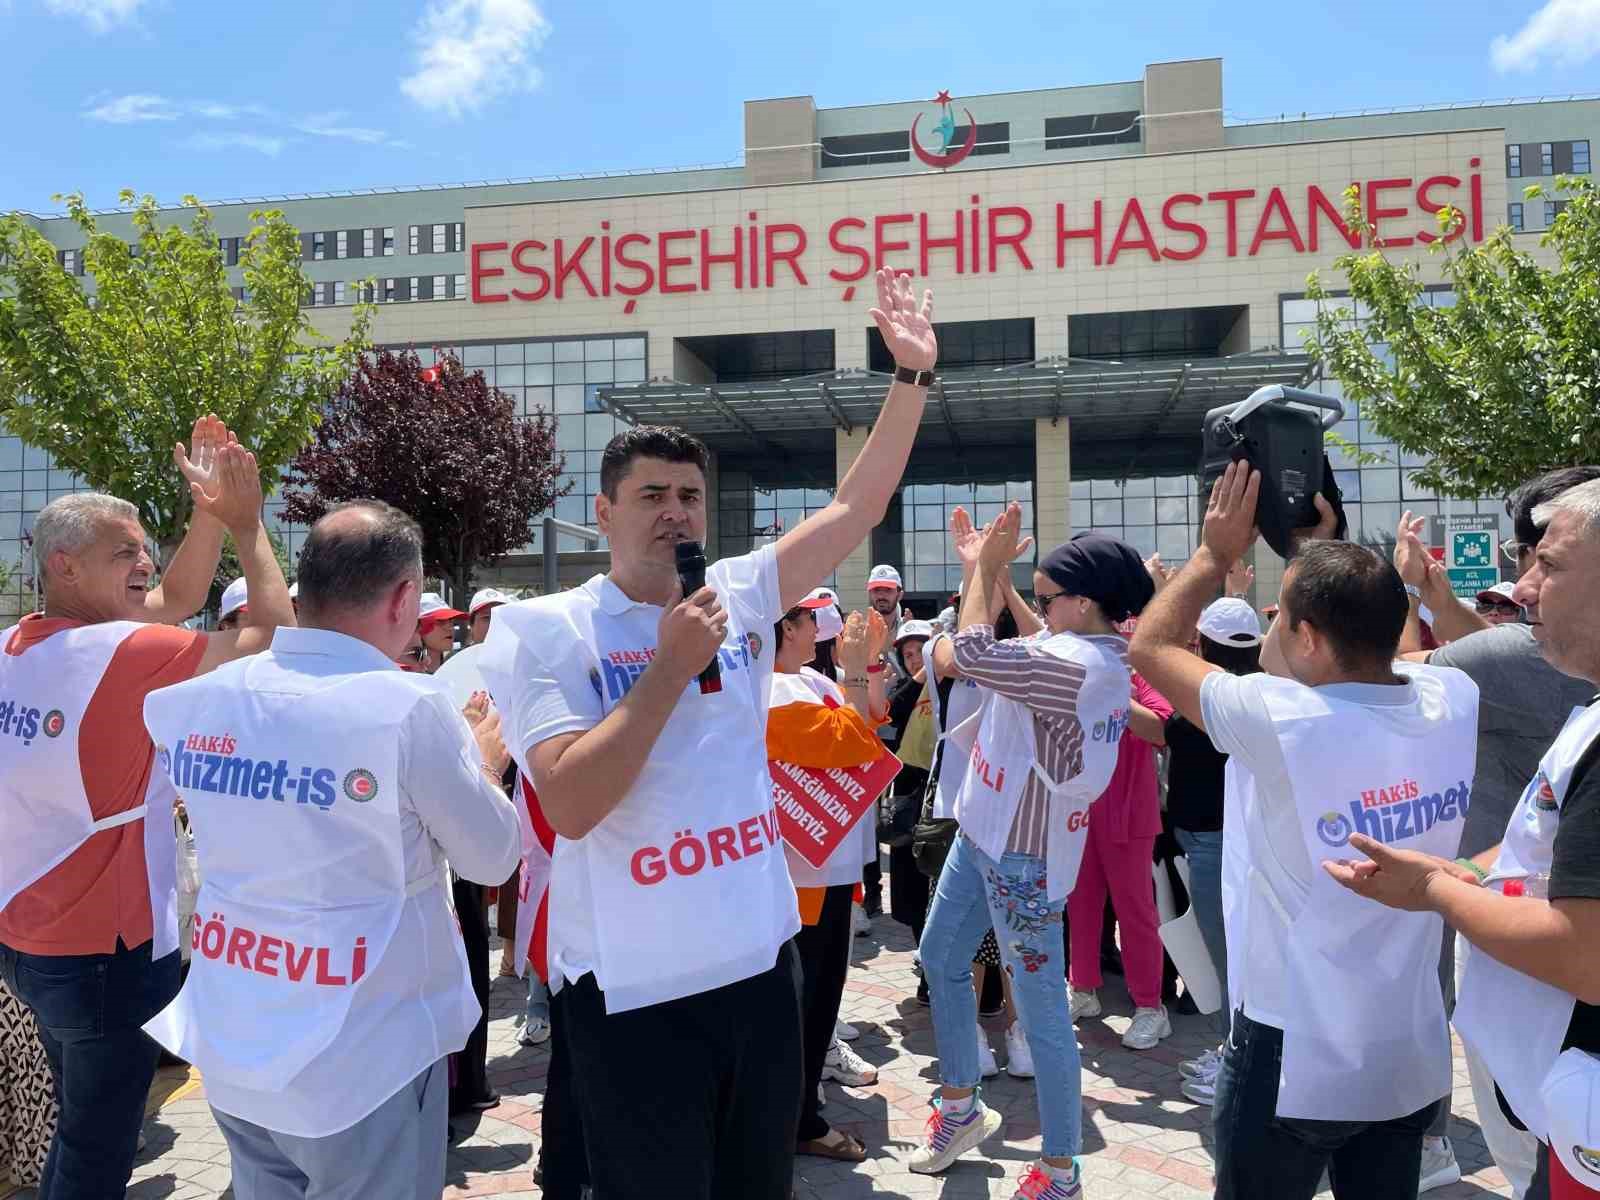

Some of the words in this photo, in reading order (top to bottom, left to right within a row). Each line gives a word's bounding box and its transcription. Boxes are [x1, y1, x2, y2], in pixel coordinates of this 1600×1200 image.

[471, 211, 808, 314] ESKİŞEHİR
[828, 194, 1034, 301] ŞEHİR
[1055, 157, 1485, 269] HASTANESİ
[0, 701, 40, 746] et-iş
[173, 739, 337, 811] hizmet-iş
[630, 808, 781, 886] GÖREV
[1350, 780, 1470, 843] hizmet
